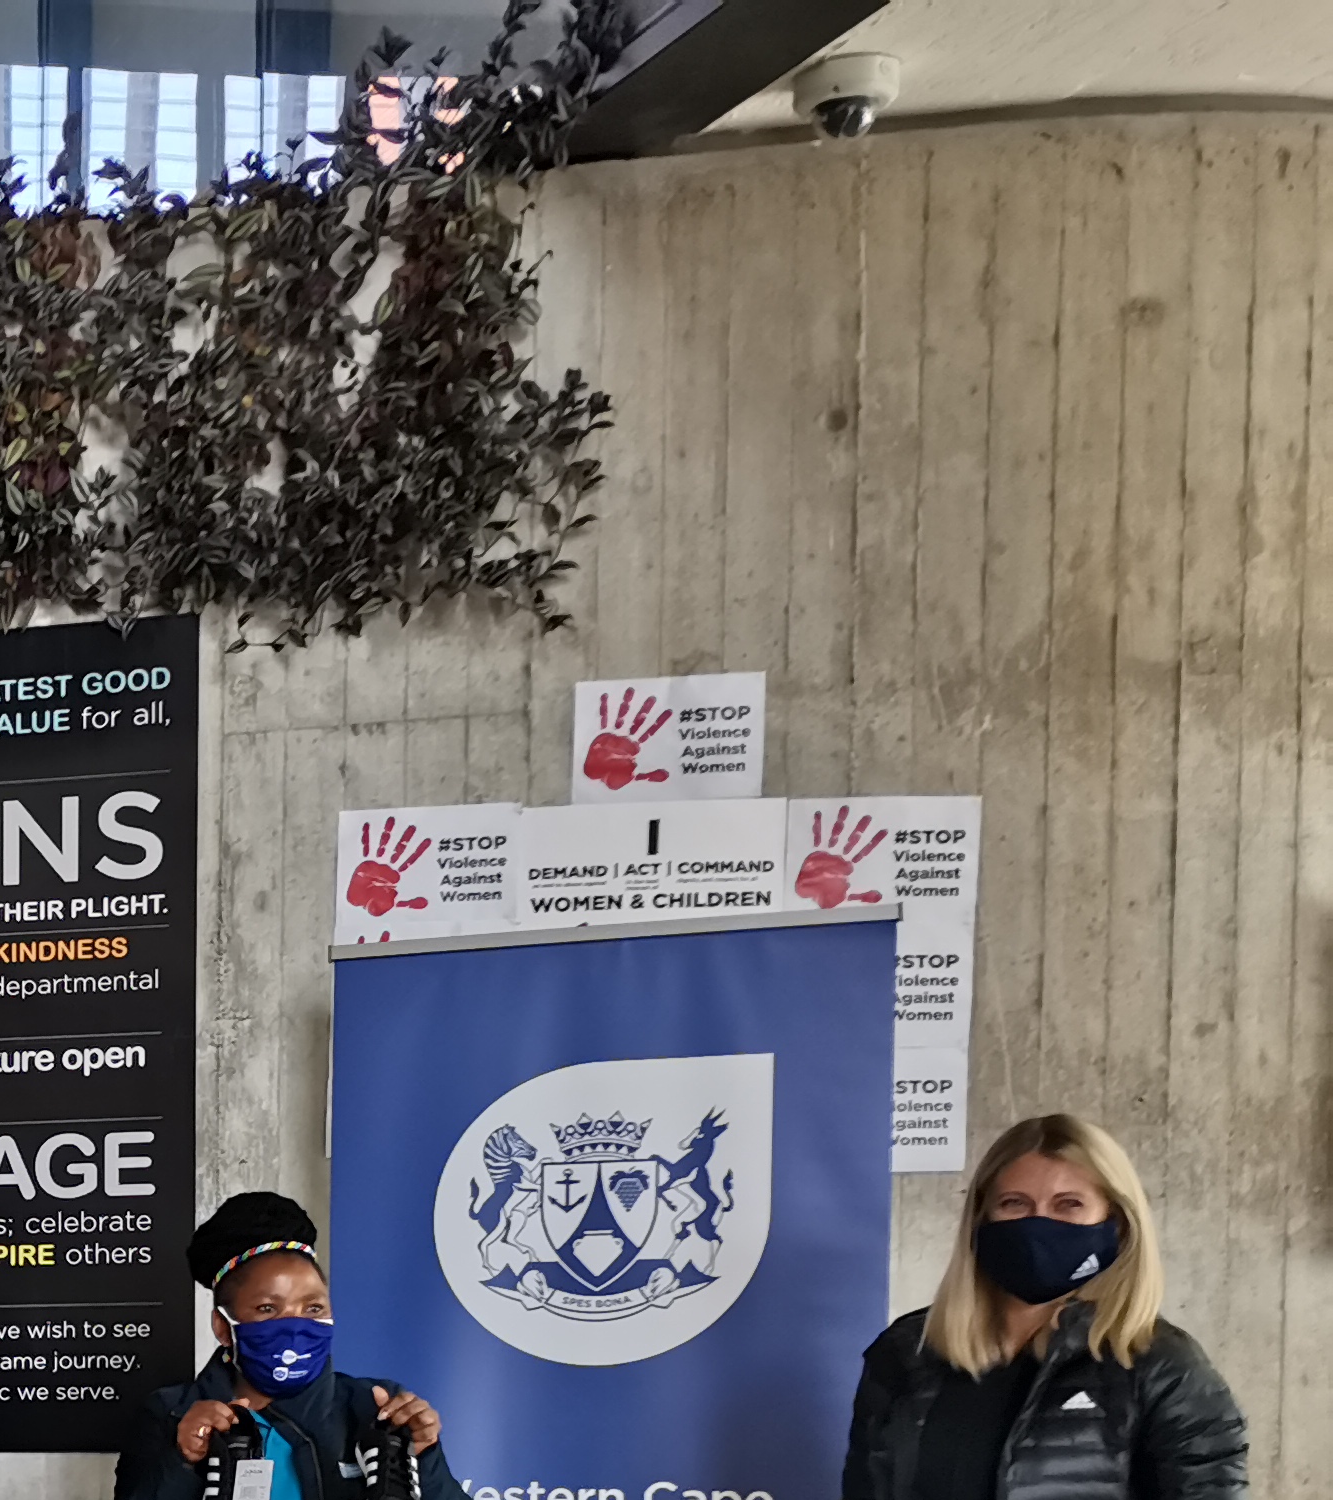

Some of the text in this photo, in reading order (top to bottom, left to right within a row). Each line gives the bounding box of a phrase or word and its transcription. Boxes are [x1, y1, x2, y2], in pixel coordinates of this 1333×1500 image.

[82, 667, 171, 695] GOOD
[81, 706, 121, 729] for
[133, 700, 170, 726] all,
[679, 706, 751, 723] #STOP
[678, 727, 751, 740] Violence
[681, 743, 746, 759] Against
[681, 762, 745, 774] Women
[438, 836, 507, 852] #STOP
[647, 819, 660, 855] I
[894, 830, 966, 844] #STOP
[437, 857, 507, 869] Violence
[893, 850, 965, 862] Violence
[529, 861, 774, 880] DEMAND ACT COMMAND
[895, 867, 961, 882] Against
[440, 872, 503, 887] Against
[440, 891, 502, 902] Women
[895, 885, 959, 897] Women
[71, 894, 168, 919] PLIGHT.
[530, 891, 771, 913] WOMEN & CHILDREN
[898, 975, 959, 986] iolence
[62, 1046, 145, 1076] open
[896, 1080, 953, 1094] STOP
[893, 1116, 949, 1131] gainst
[26, 1211, 151, 1234] celebrate
[66, 1243, 151, 1265] others
[563, 1297, 630, 1307] SPES BONA
[27, 1321, 75, 1338] wish
[83, 1321, 106, 1338] to
[113, 1323, 150, 1337] see
[52, 1351, 140, 1373] journey.
[17, 1386, 119, 1400] we serve.
